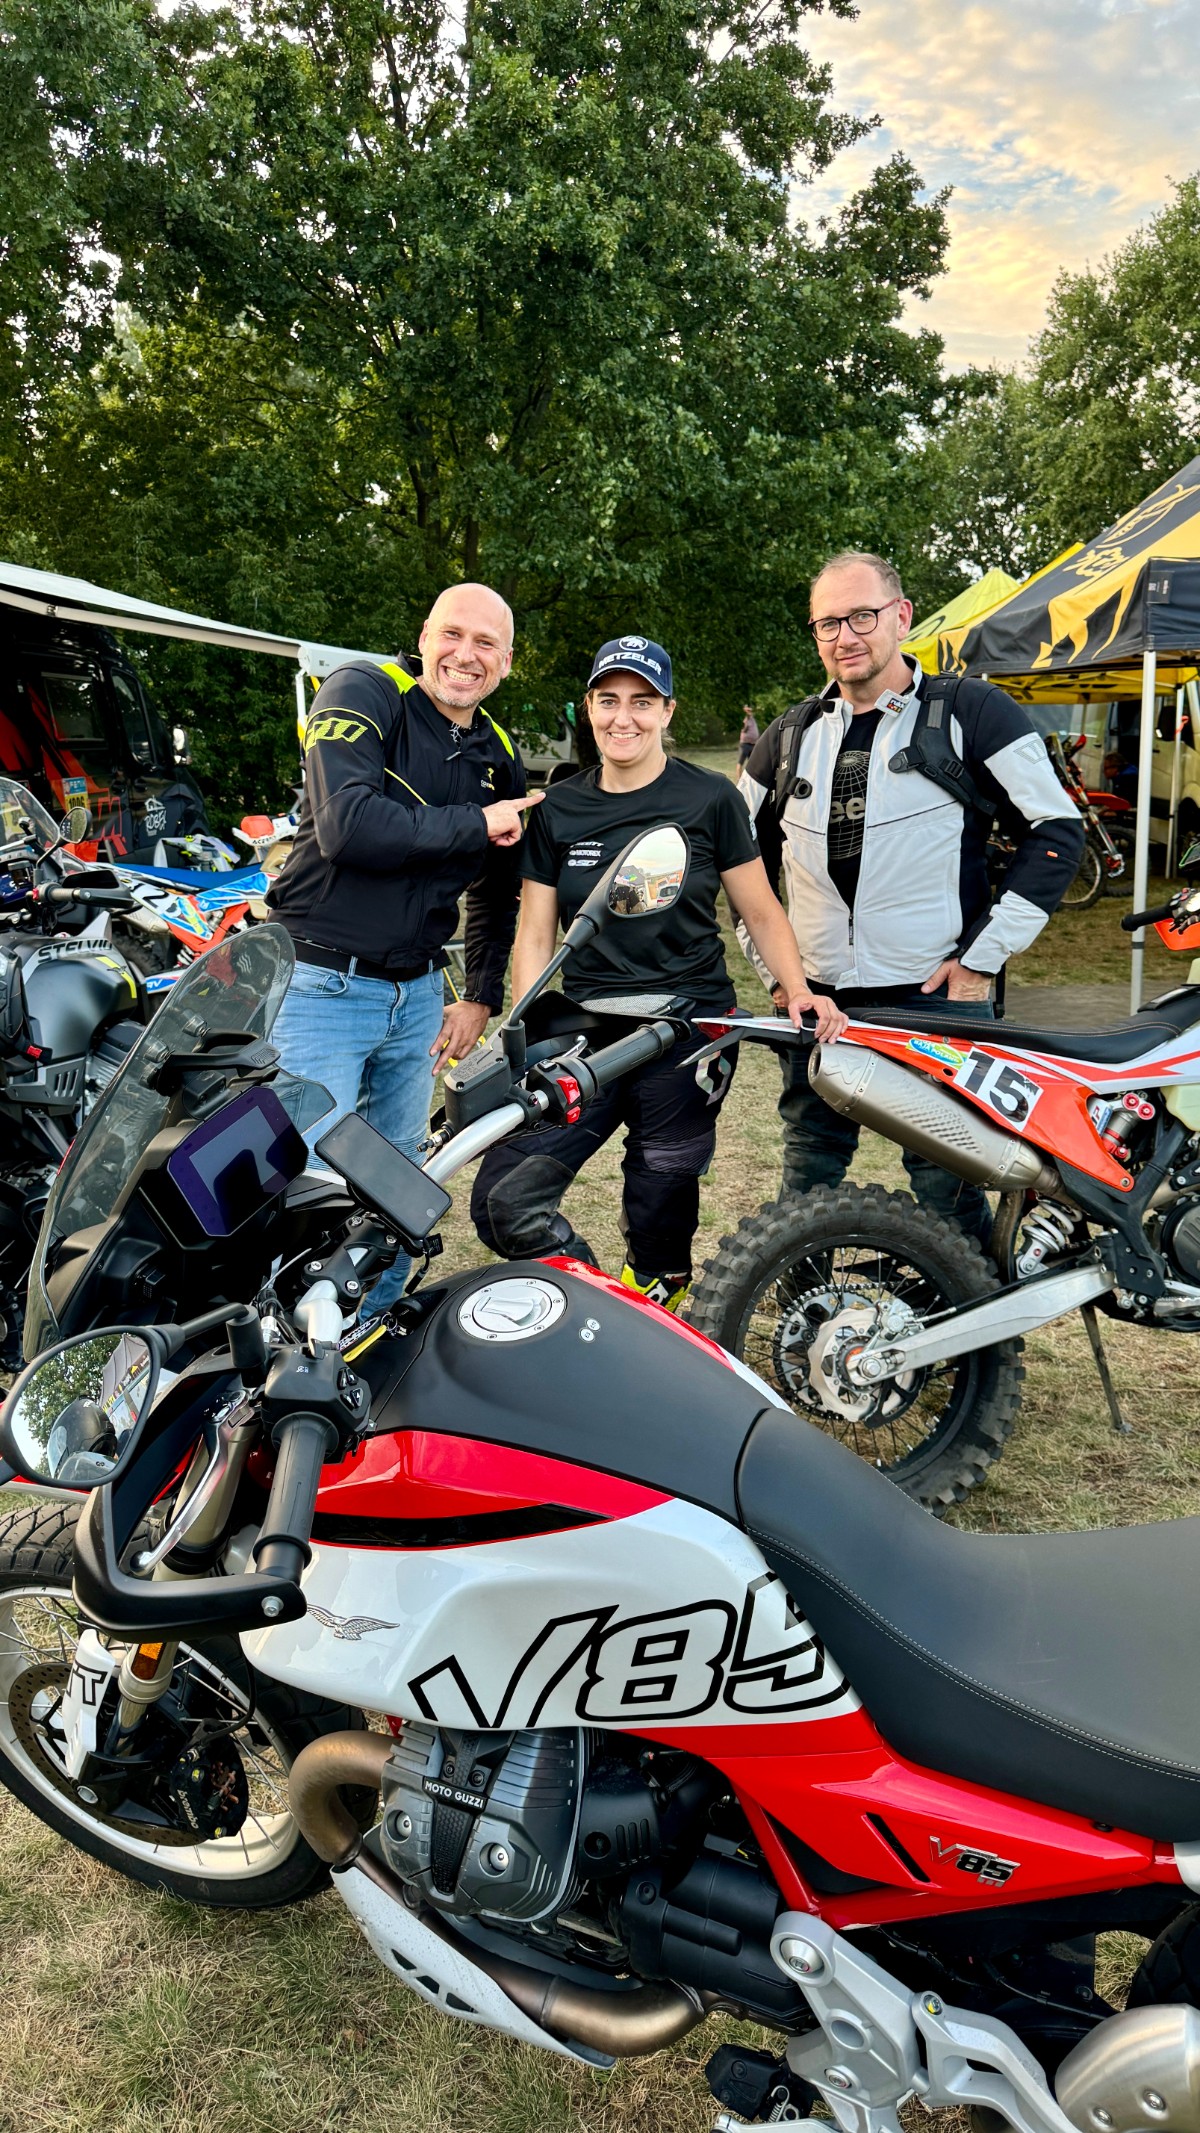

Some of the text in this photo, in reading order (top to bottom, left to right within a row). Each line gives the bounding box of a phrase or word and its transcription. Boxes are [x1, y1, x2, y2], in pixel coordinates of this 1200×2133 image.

[598, 651, 662, 676] METZELER
[913, 1039, 931, 1051] BAJA
[963, 1050, 1041, 1123] 15
[407, 1571, 853, 1729] V85
[177, 1789, 200, 1829] brembo
[425, 1781, 484, 1808] MOTO GUZZI
[929, 1835, 1021, 1882] V85
